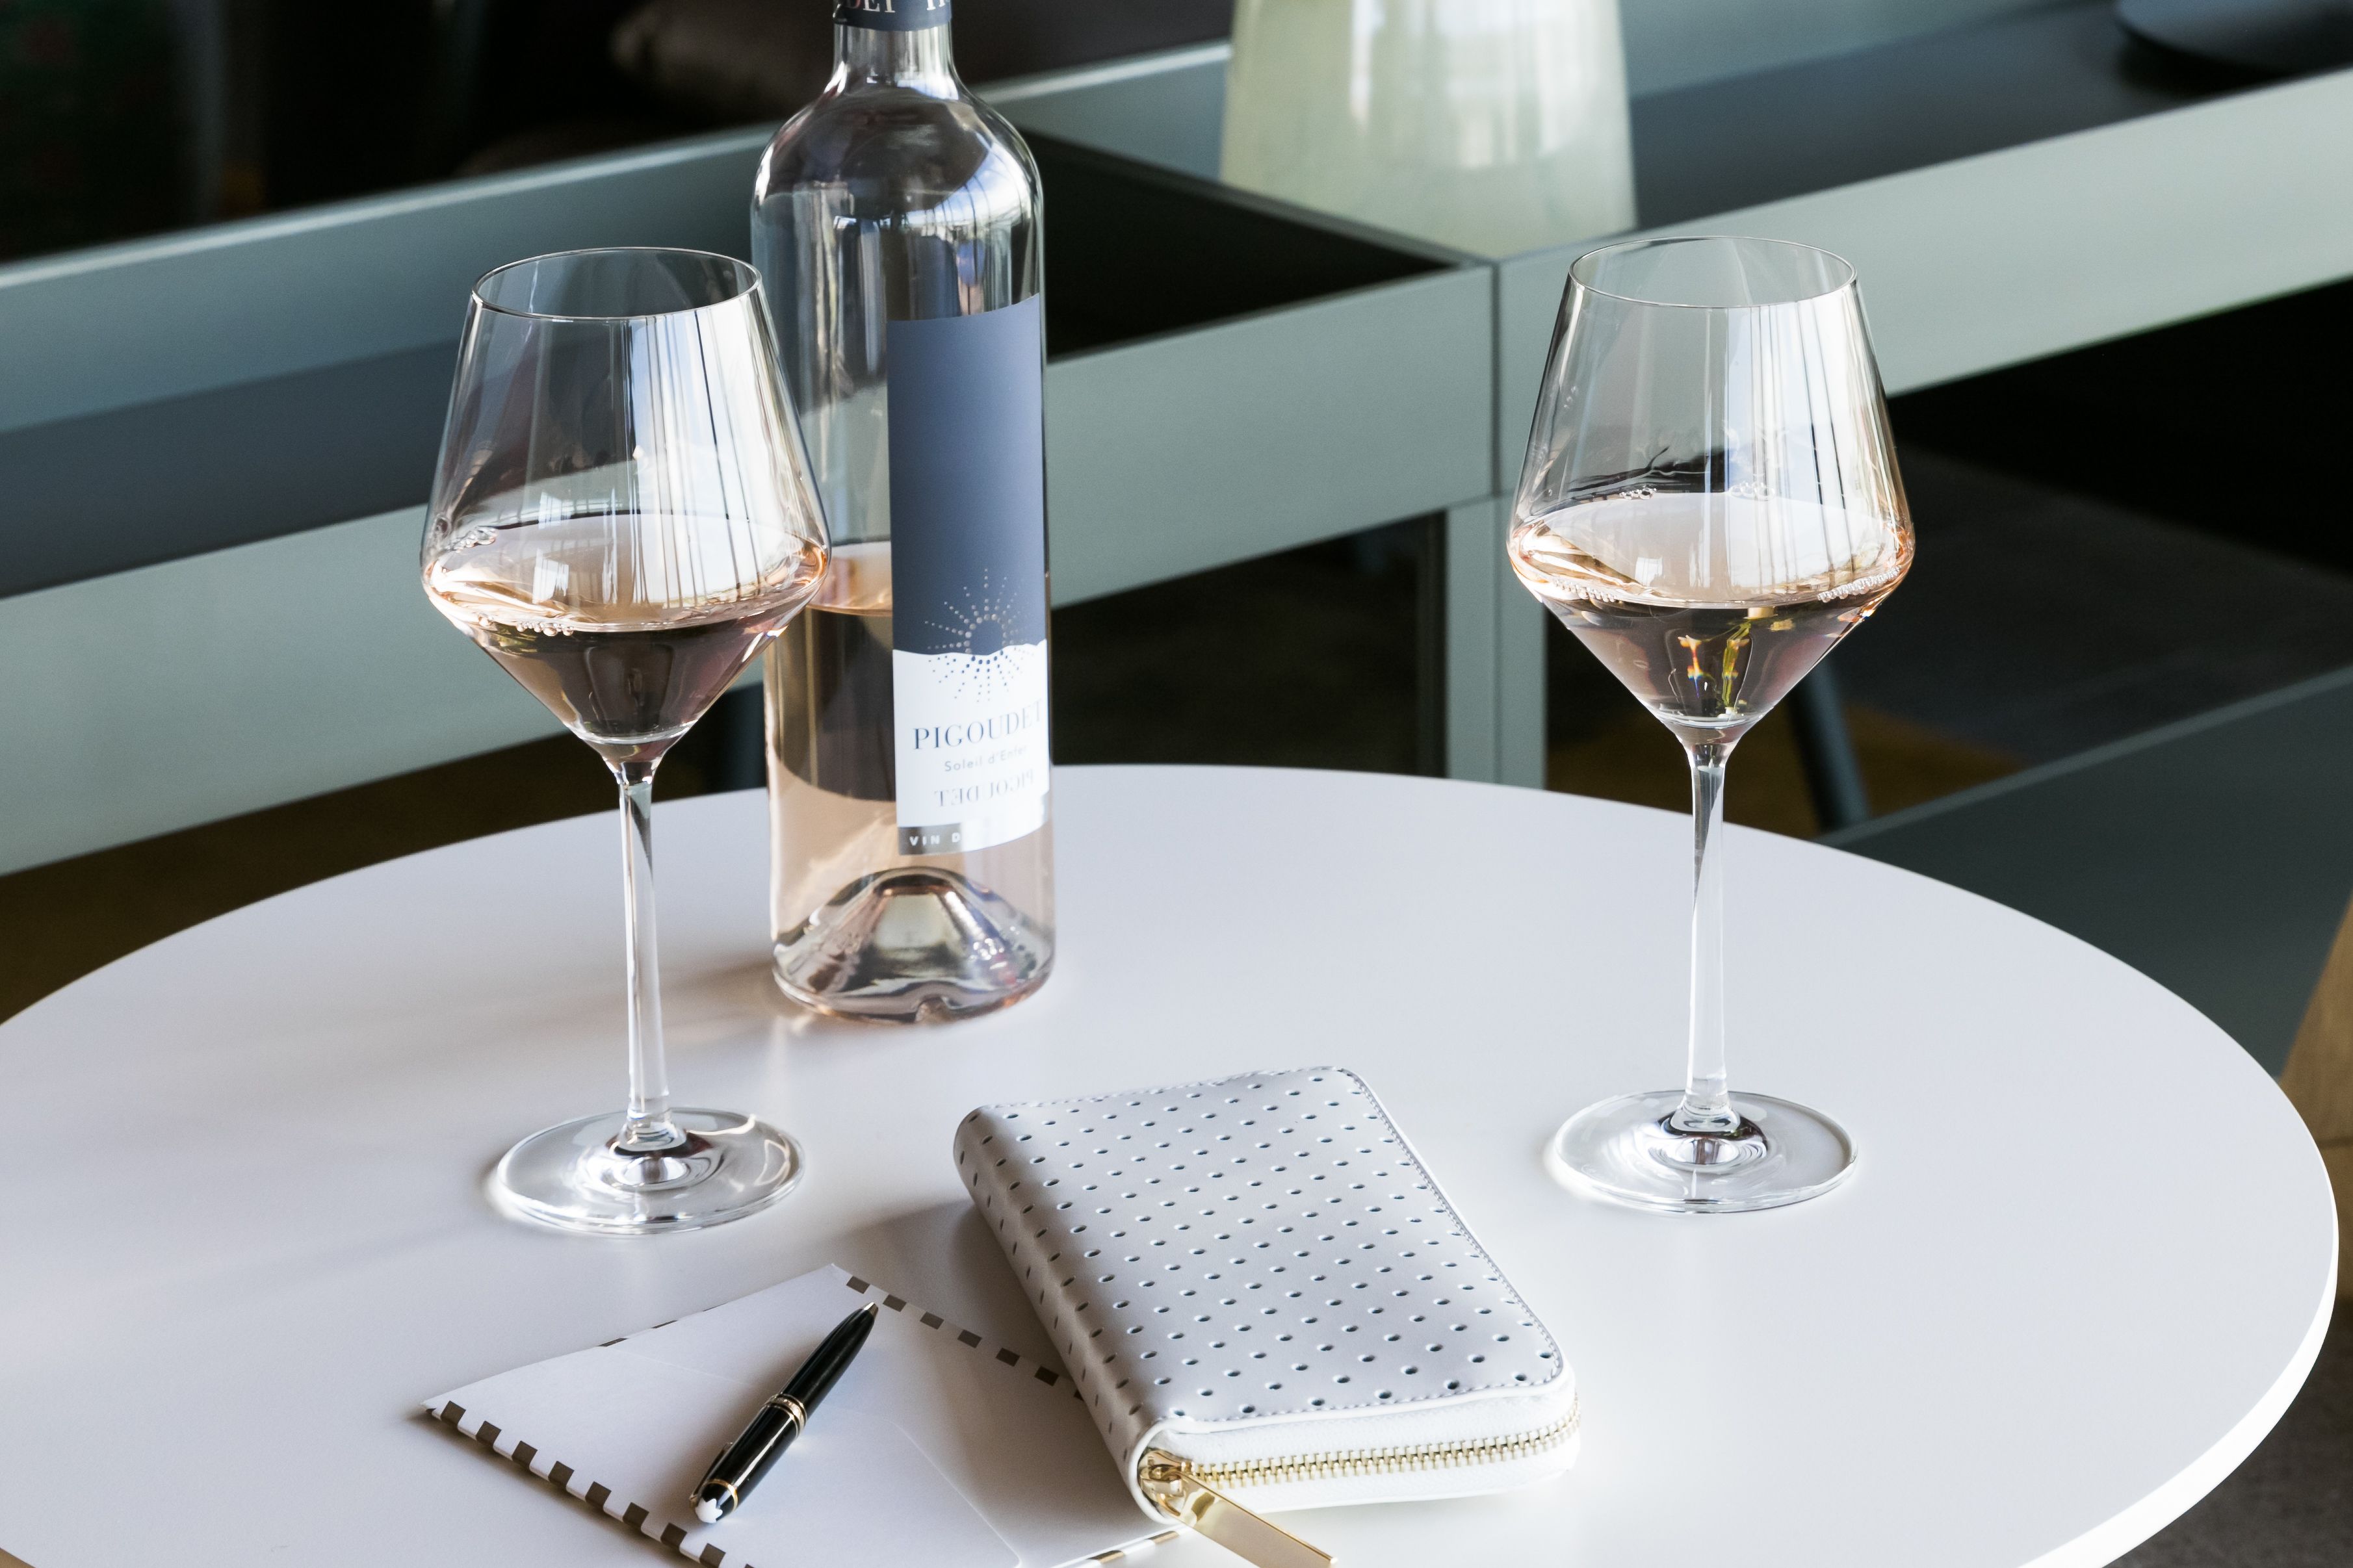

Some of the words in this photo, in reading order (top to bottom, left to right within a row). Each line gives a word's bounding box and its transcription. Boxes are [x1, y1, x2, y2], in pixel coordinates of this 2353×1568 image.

[913, 699, 1042, 750] PIGOUDET
[944, 756, 983, 772] Soleil
[909, 834, 941, 847] VIN
